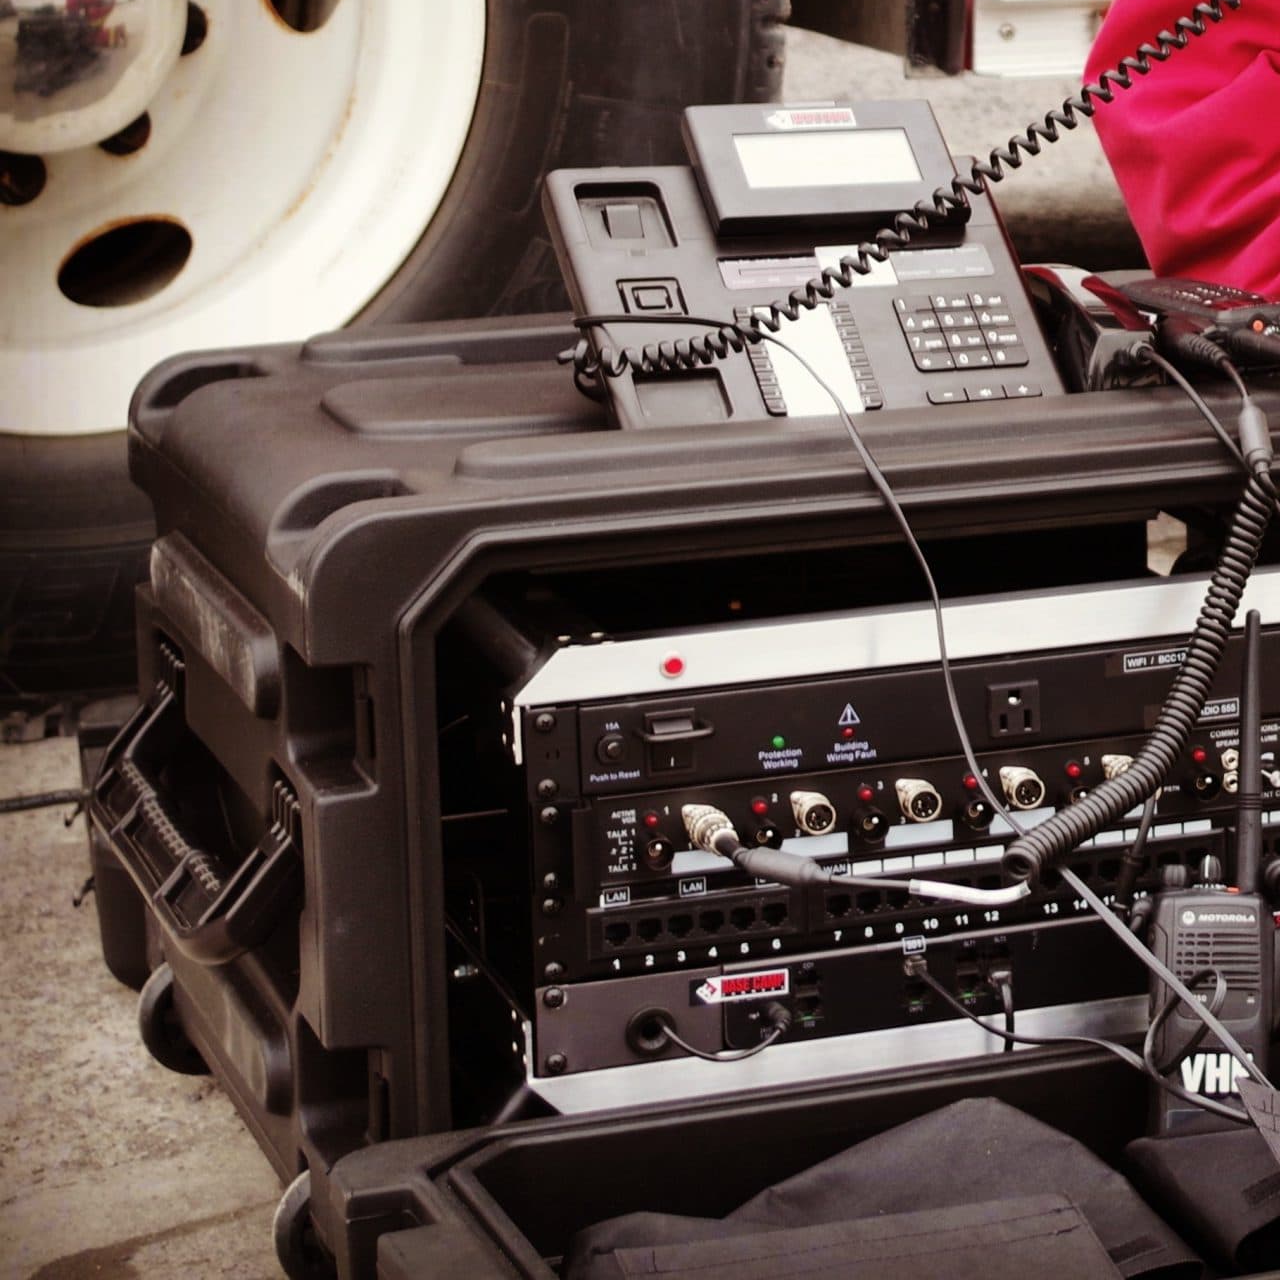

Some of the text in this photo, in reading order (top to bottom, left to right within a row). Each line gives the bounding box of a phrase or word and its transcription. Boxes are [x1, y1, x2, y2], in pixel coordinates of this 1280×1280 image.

[898, 299, 906, 311] 1
[936, 296, 946, 307] 2
[973, 294, 983, 305] 3
[912, 337, 920, 348] 7
[988, 331, 997, 343] 9
[1128, 657, 1147, 668] WIFI
[834, 740, 869, 753] Building
[758, 748, 803, 760] Protection
[826, 749, 877, 763] Wiring Fault
[763, 758, 798, 770] Working
[590, 770, 640, 783] Push to Reset
[664, 806, 669, 815] 1
[607, 830, 628, 839] TALK
[608, 863, 628, 872] TALK
[683, 882, 702, 893] LAN
[606, 892, 626, 902] LAN
[1043, 903, 1059, 914] 13
[1073, 899, 1088, 910] 14
[955, 914, 969, 926] 11
[984, 910, 999, 922] 12
[1198, 914, 1256, 923] MOTOROLA
[895, 922, 904, 934] 9
[923, 918, 939, 930] 10
[834, 930, 842, 941] 7
[864, 926, 873, 938] 8
[740, 943, 749, 953] 5
[772, 939, 781, 949] 6
[677, 951, 686, 962] 3
[708, 947, 717, 957] 4
[613, 959, 621, 970] 1
[645, 955, 654, 966] 2
